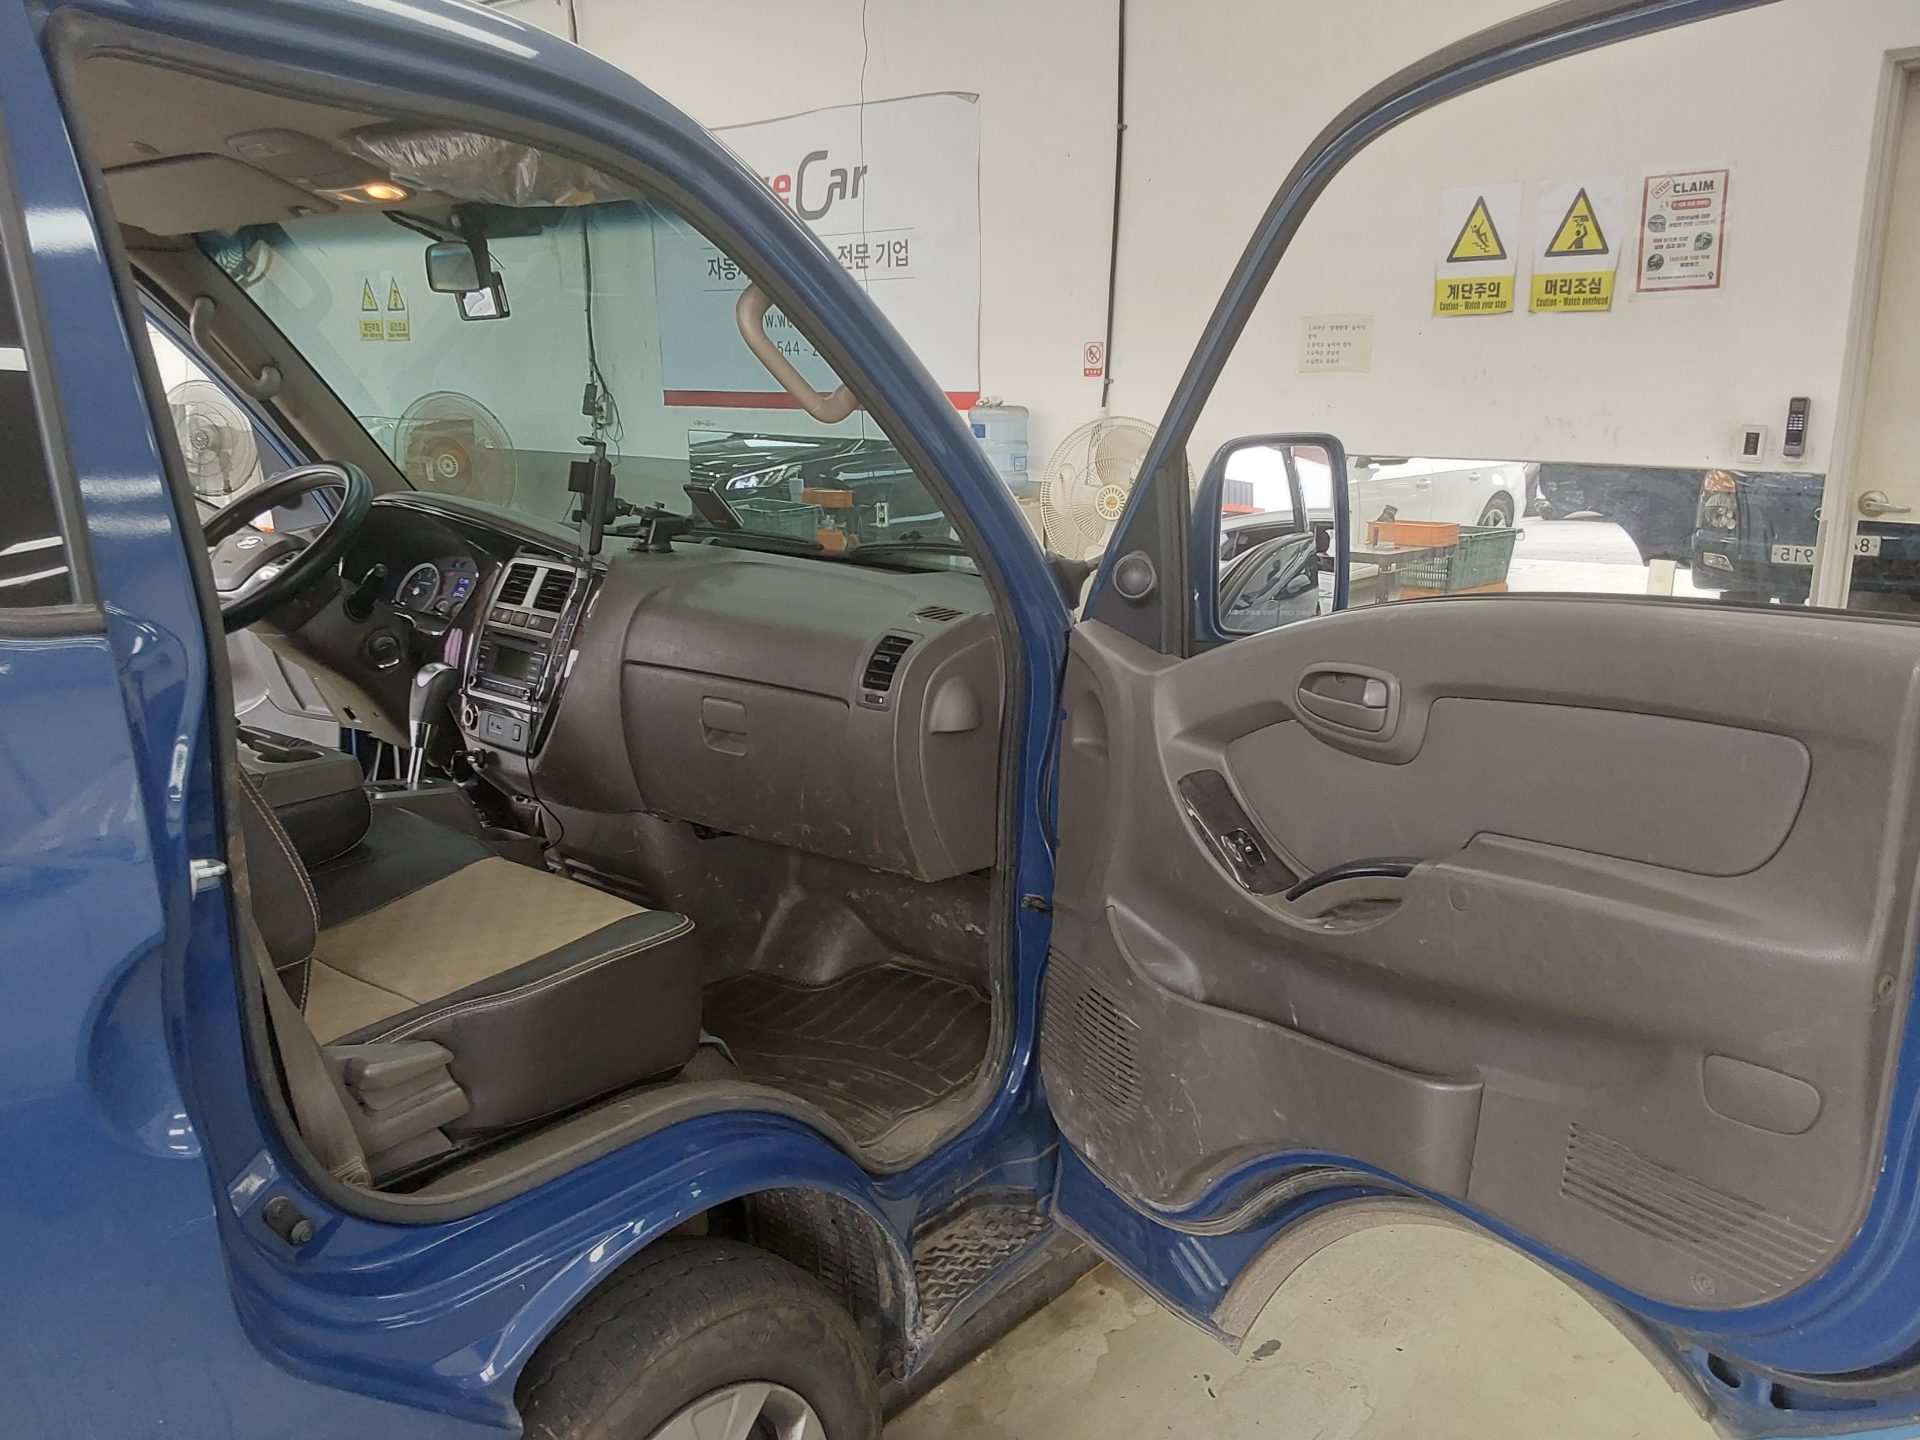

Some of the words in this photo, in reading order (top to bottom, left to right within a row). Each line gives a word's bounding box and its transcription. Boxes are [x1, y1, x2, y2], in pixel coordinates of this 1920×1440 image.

[764, 150, 868, 220] eCar
[1673, 181, 1714, 194] CLAIM
[708, 257, 741, 280] 자동
[838, 243, 870, 269] 전문
[876, 239, 908, 268] 기업
[1447, 282, 1501, 300] 계단주의
[1545, 277, 1602, 295] 머리조심
[1440, 302, 1459, 311] Caution
[1465, 300, 1480, 310] Watch
[1482, 301, 1494, 311] your
[1495, 300, 1507, 309] step
[1536, 298, 1557, 307] Caution
[1563, 296, 1580, 306] Watch
